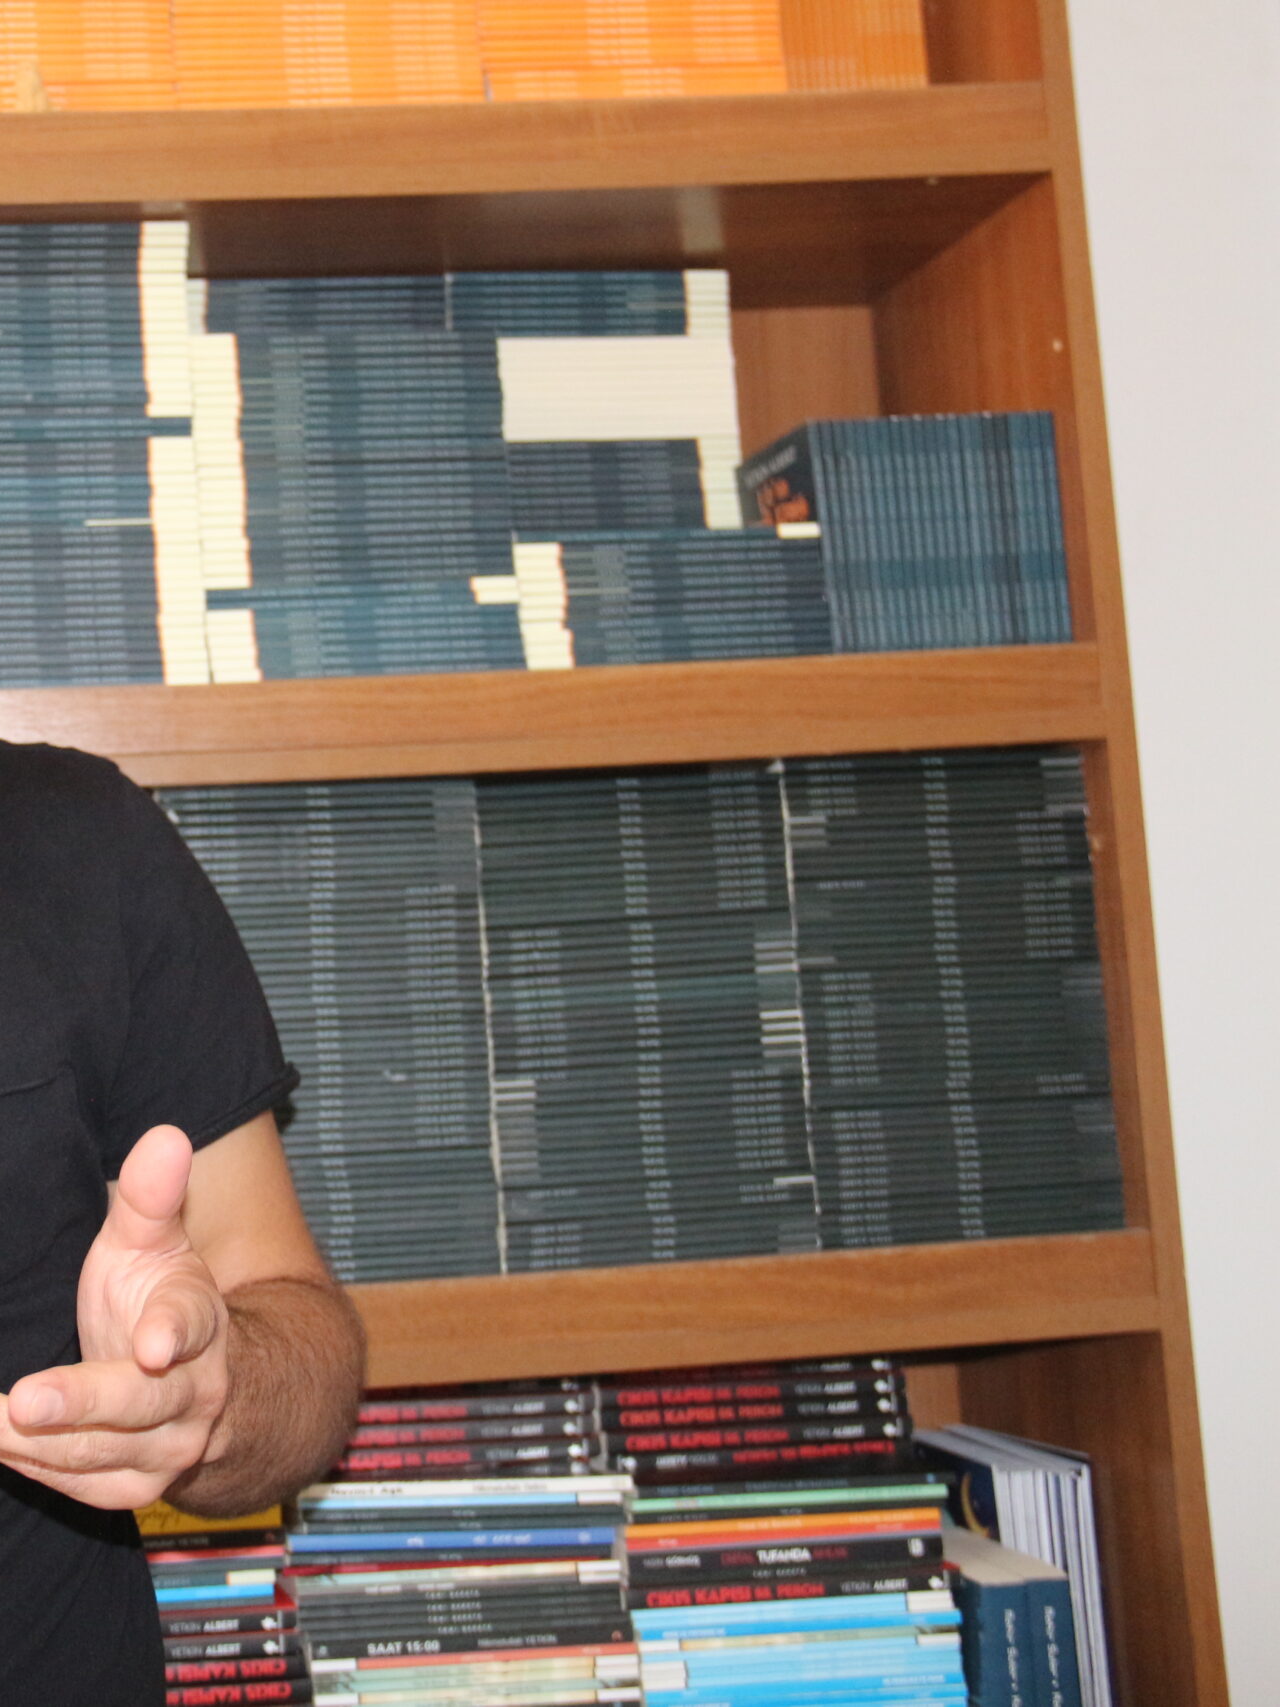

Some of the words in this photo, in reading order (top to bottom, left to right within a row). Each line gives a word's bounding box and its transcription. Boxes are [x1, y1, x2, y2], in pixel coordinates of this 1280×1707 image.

[203, 1618, 239, 1632] ALBERT
[205, 1643, 241, 1656] ALBERT
[367, 1642, 402, 1656] SAAT
